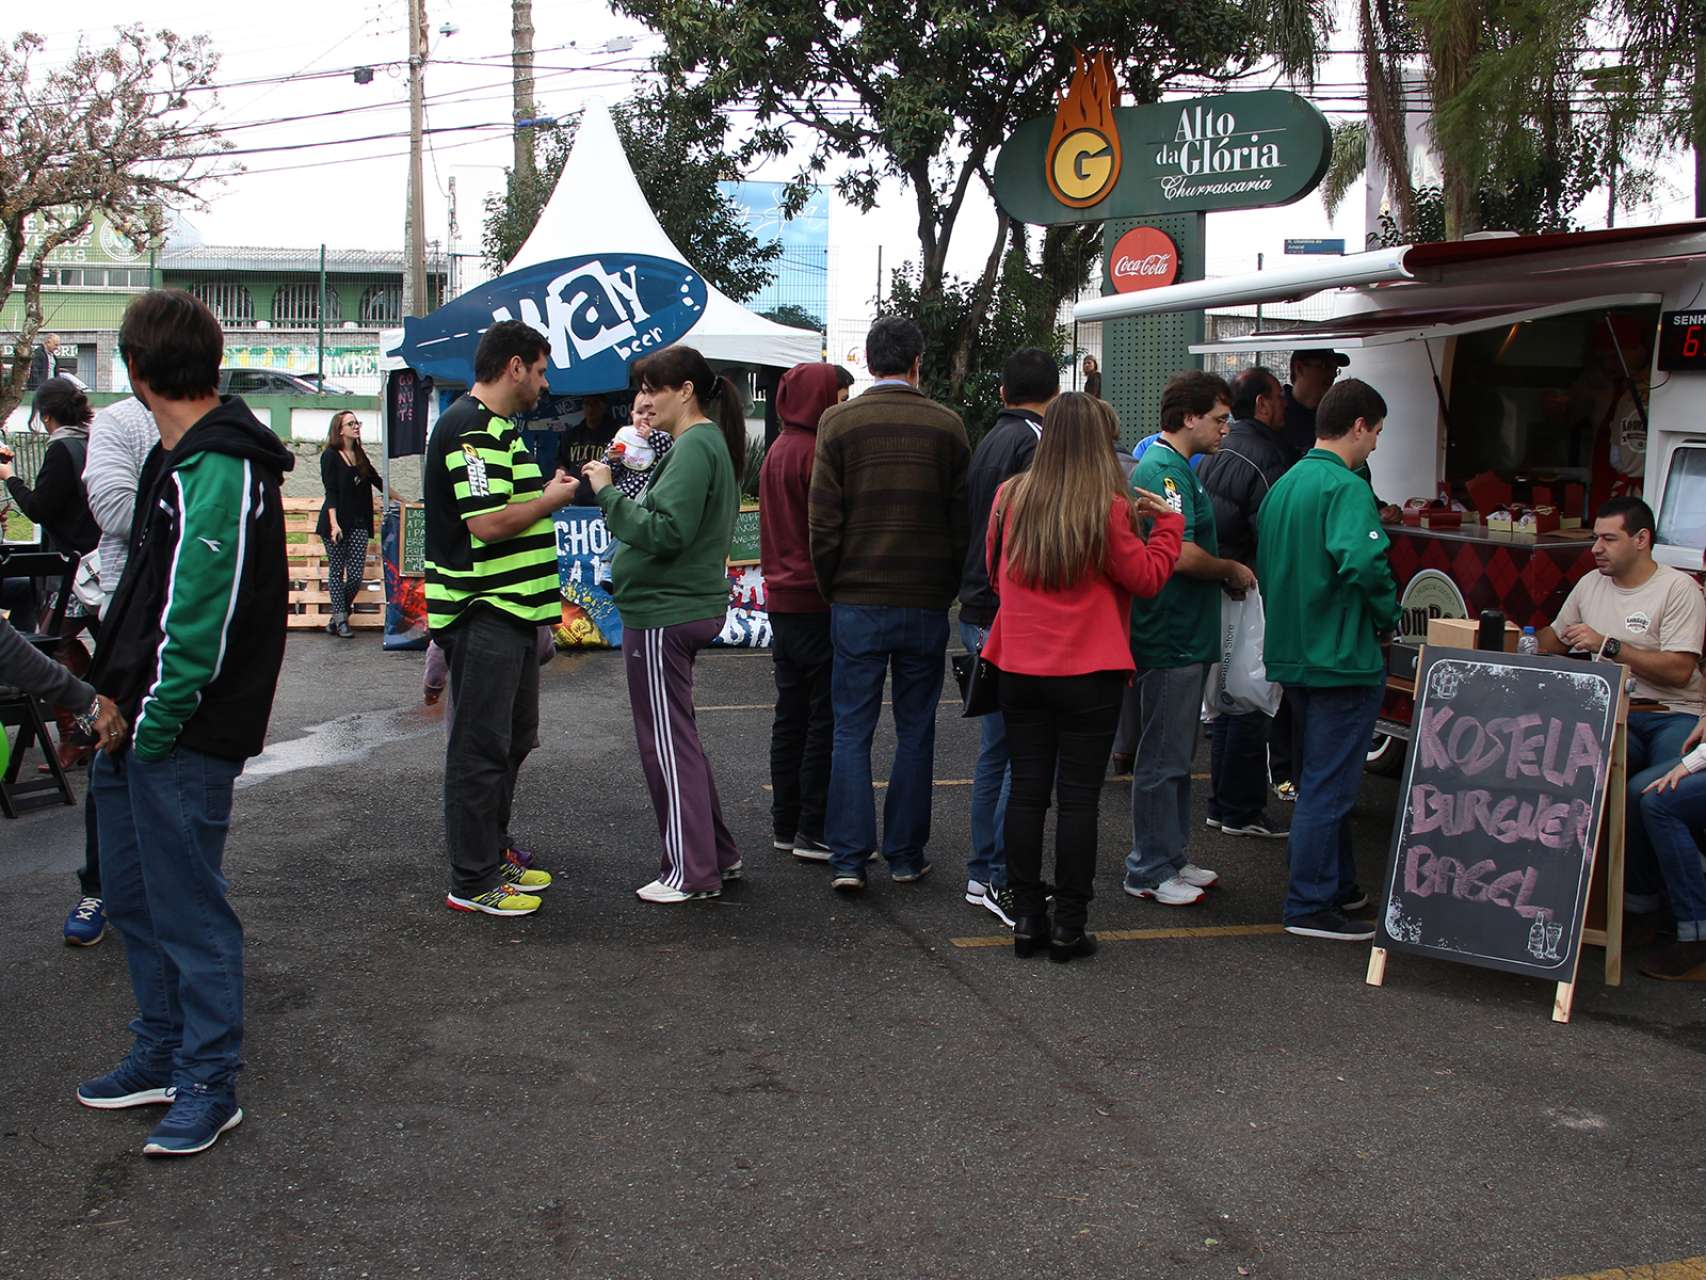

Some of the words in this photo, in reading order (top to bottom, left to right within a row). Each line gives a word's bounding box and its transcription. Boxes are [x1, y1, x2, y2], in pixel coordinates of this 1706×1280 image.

[1174, 105, 1236, 142] Alto
[1055, 131, 1112, 199] G
[1156, 144, 1179, 165] da
[1180, 134, 1281, 175] Glória
[1161, 174, 1273, 200] Churrascaria
[1115, 253, 1172, 277] Coca-Cola
[612, 327, 663, 361] beer
[467, 464, 481, 496] PRO
[477, 459, 491, 497] TORK
[553, 519, 612, 556] CHO
[1418, 706, 1606, 791] KOSTELA
